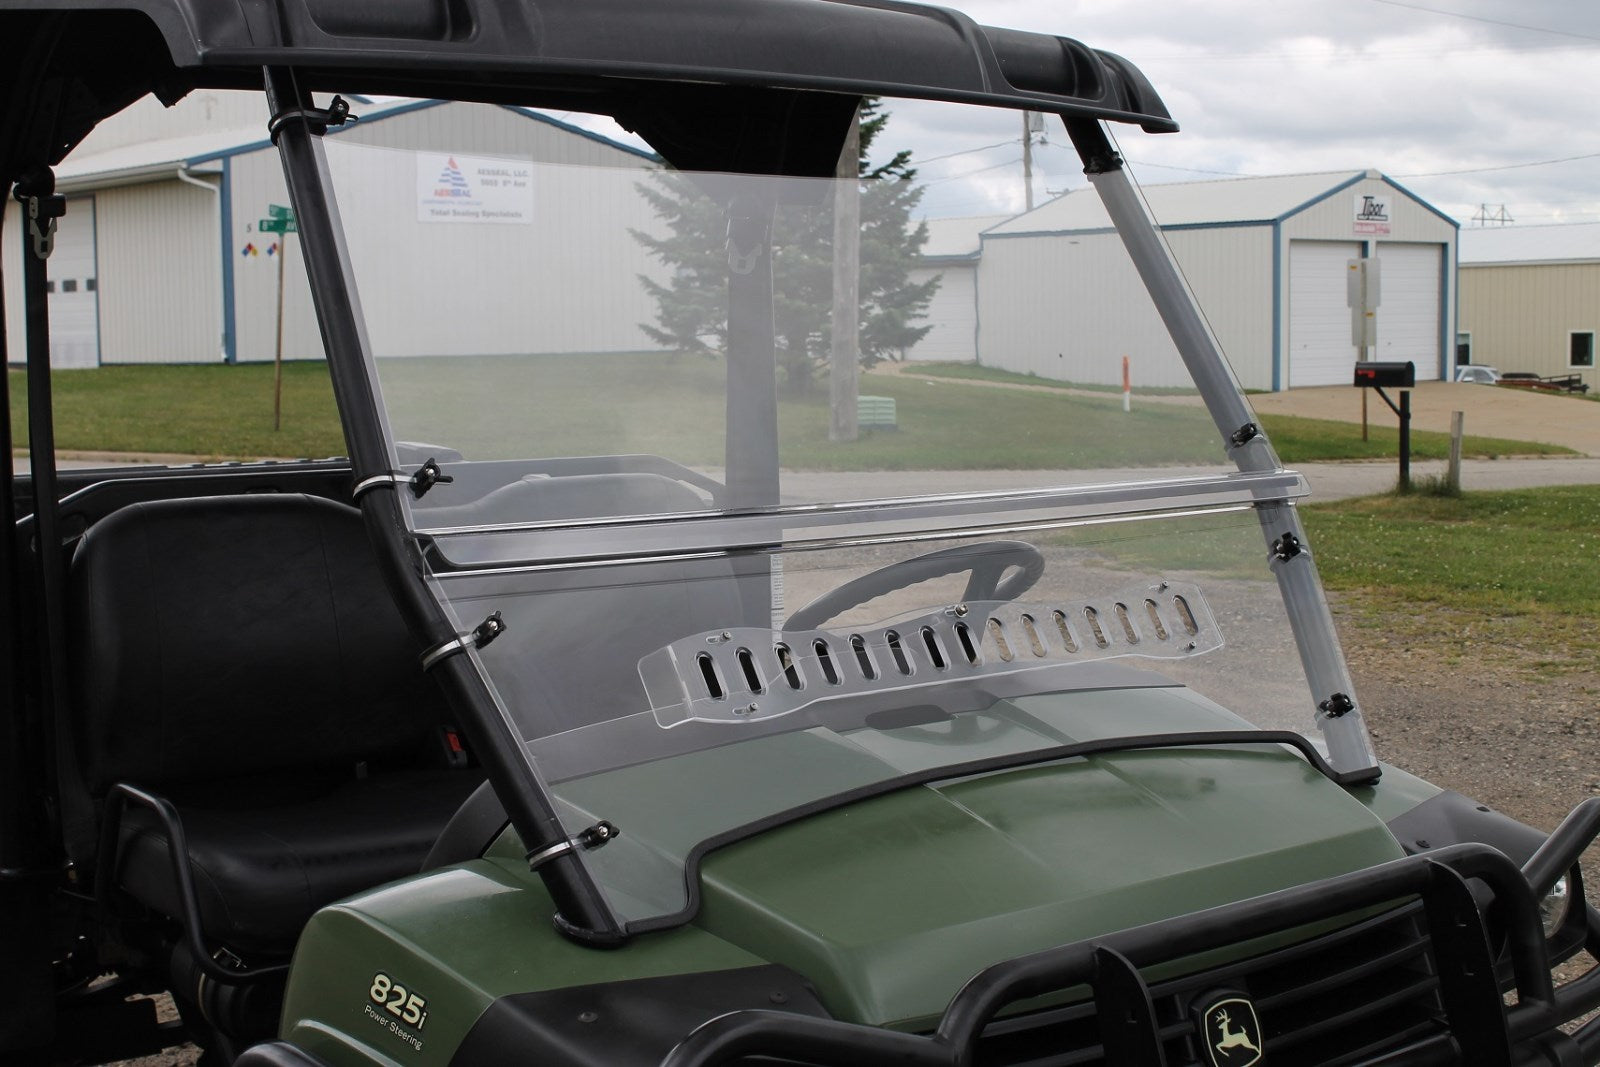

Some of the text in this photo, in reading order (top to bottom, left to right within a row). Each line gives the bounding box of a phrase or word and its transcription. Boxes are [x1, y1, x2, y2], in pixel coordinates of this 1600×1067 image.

[430, 208, 523, 218] Total Sealing Specialists
[370, 974, 427, 1029] 825i
[364, 1004, 423, 1051] Power Steering
